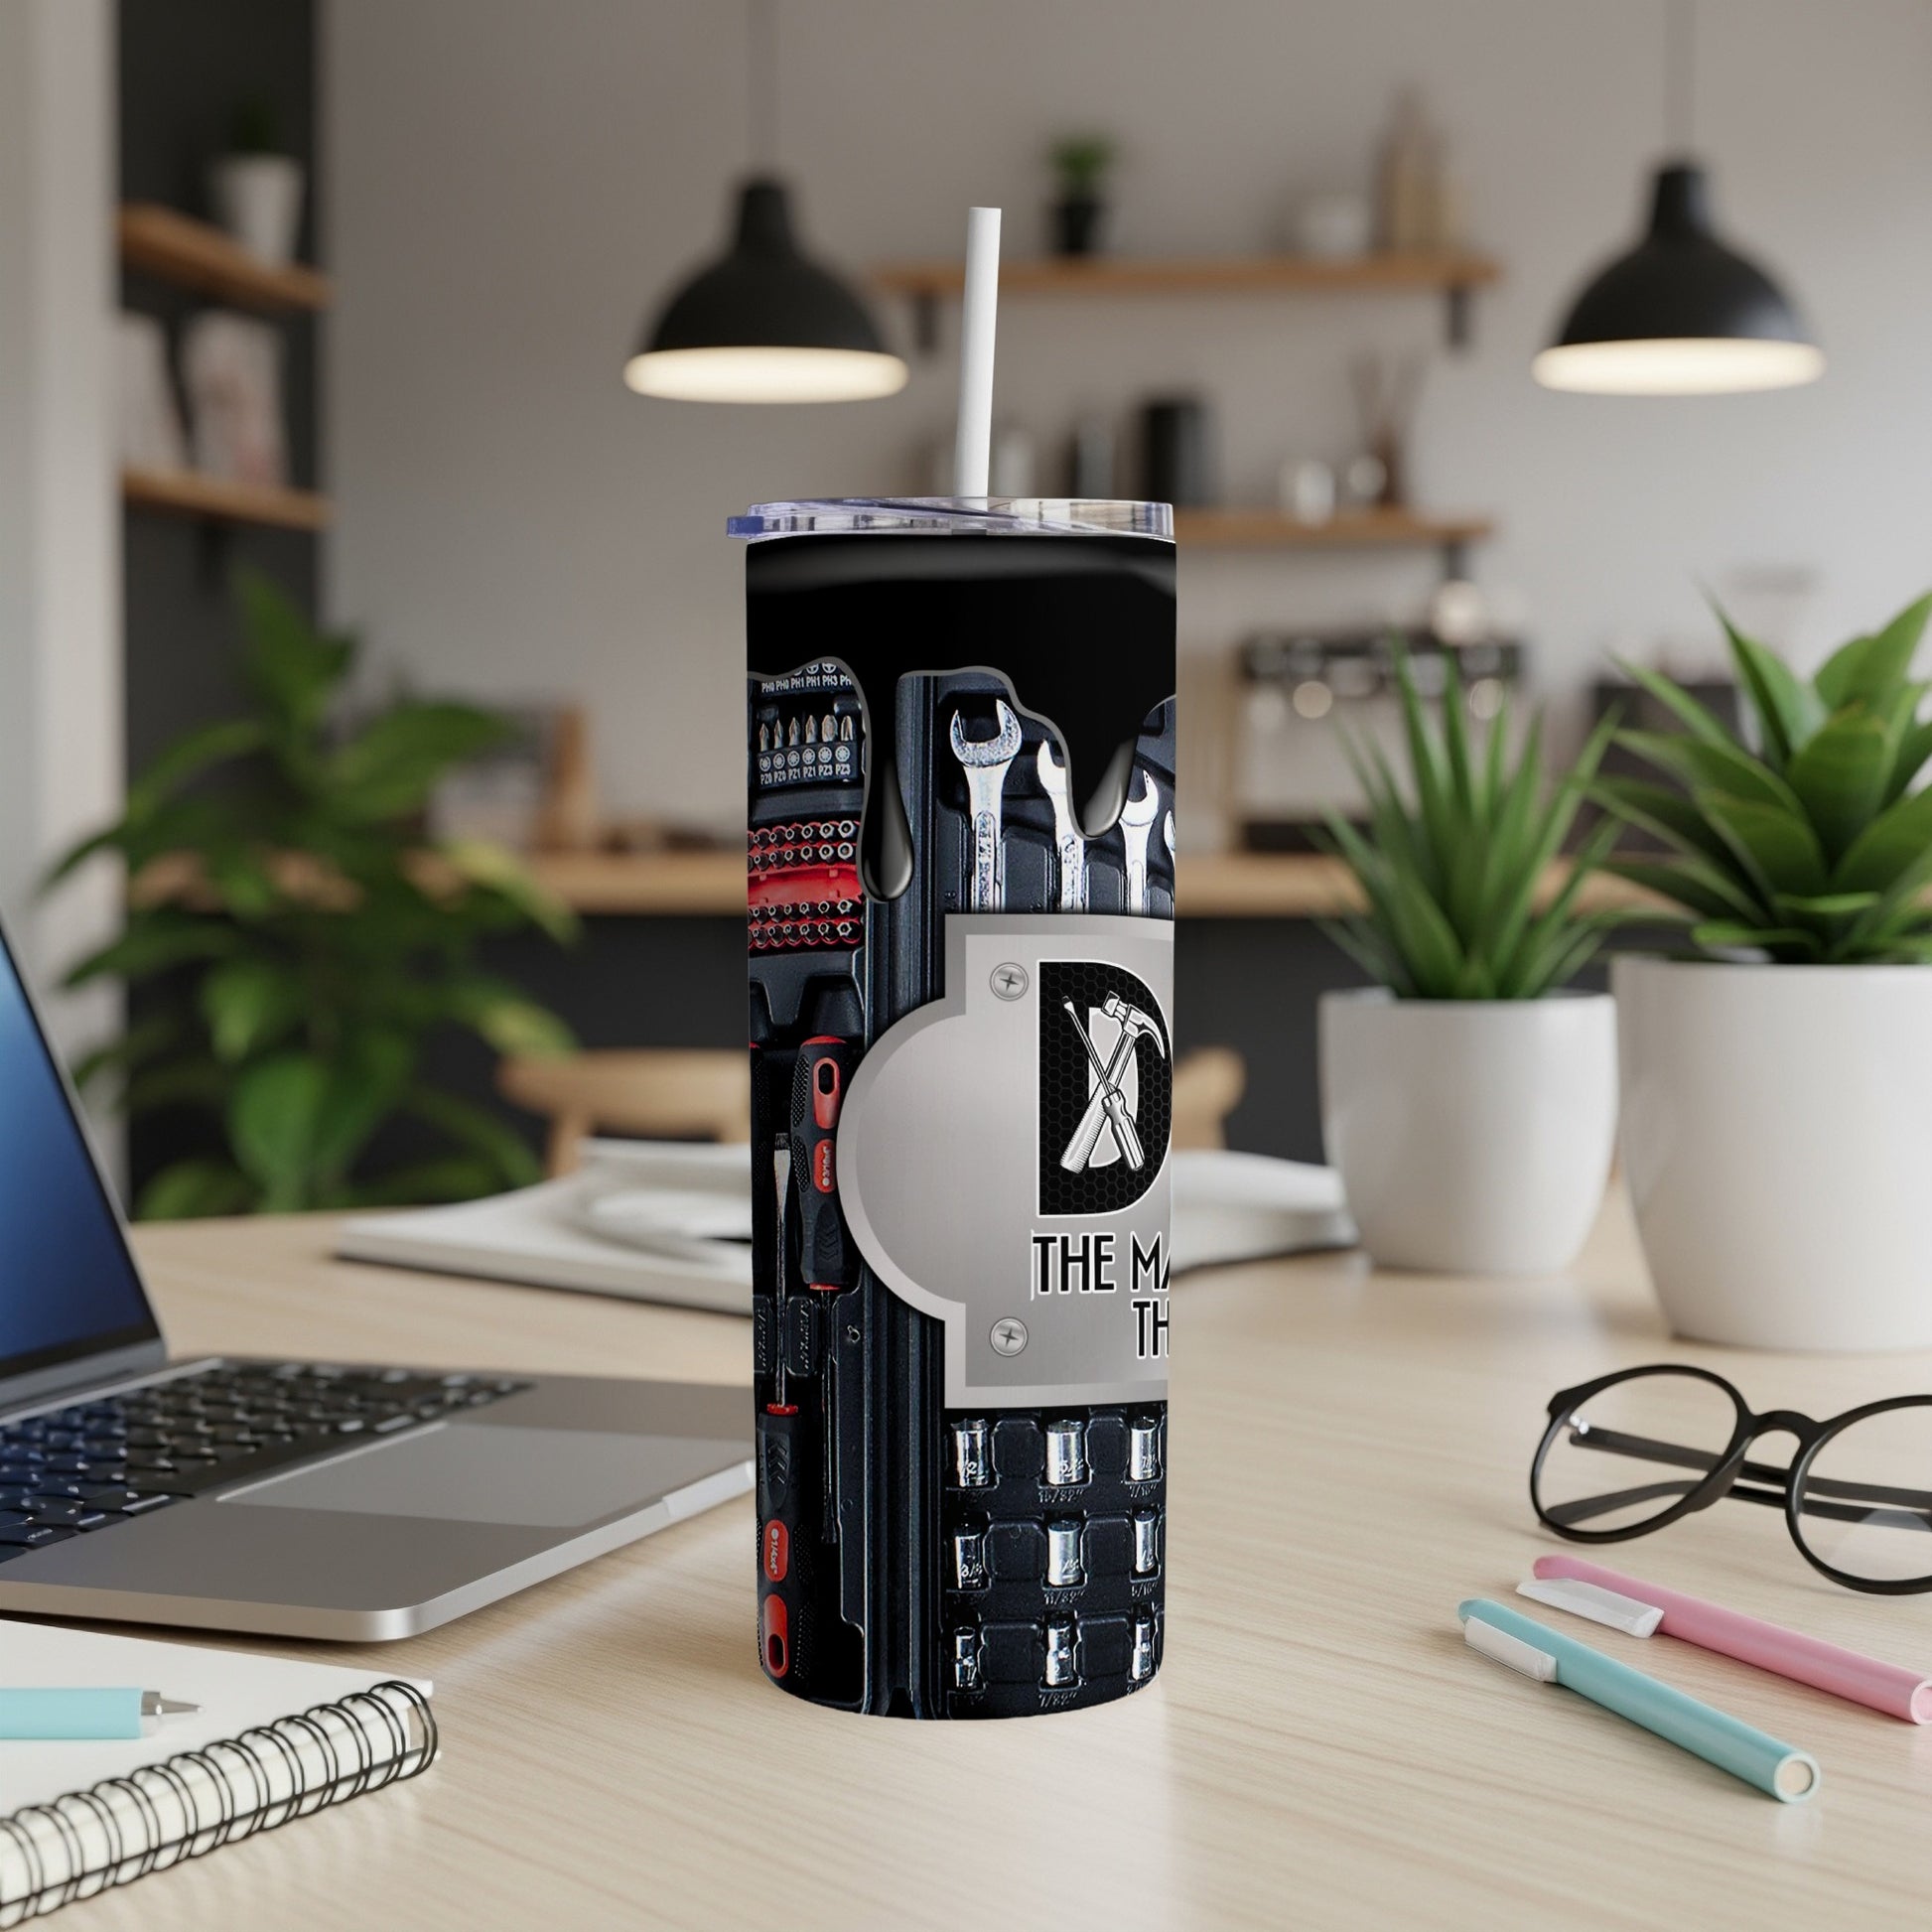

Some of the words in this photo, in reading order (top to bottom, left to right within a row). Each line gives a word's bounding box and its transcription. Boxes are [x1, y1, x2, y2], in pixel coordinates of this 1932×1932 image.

[790, 677, 804, 689] PH1
[805, 676, 820, 687] PH1
[802, 766, 816, 778] PZ1
[818, 764, 833, 775] PZ3
[835, 763, 851, 774] PZ3
[1031, 1232, 1117, 1295] THE
